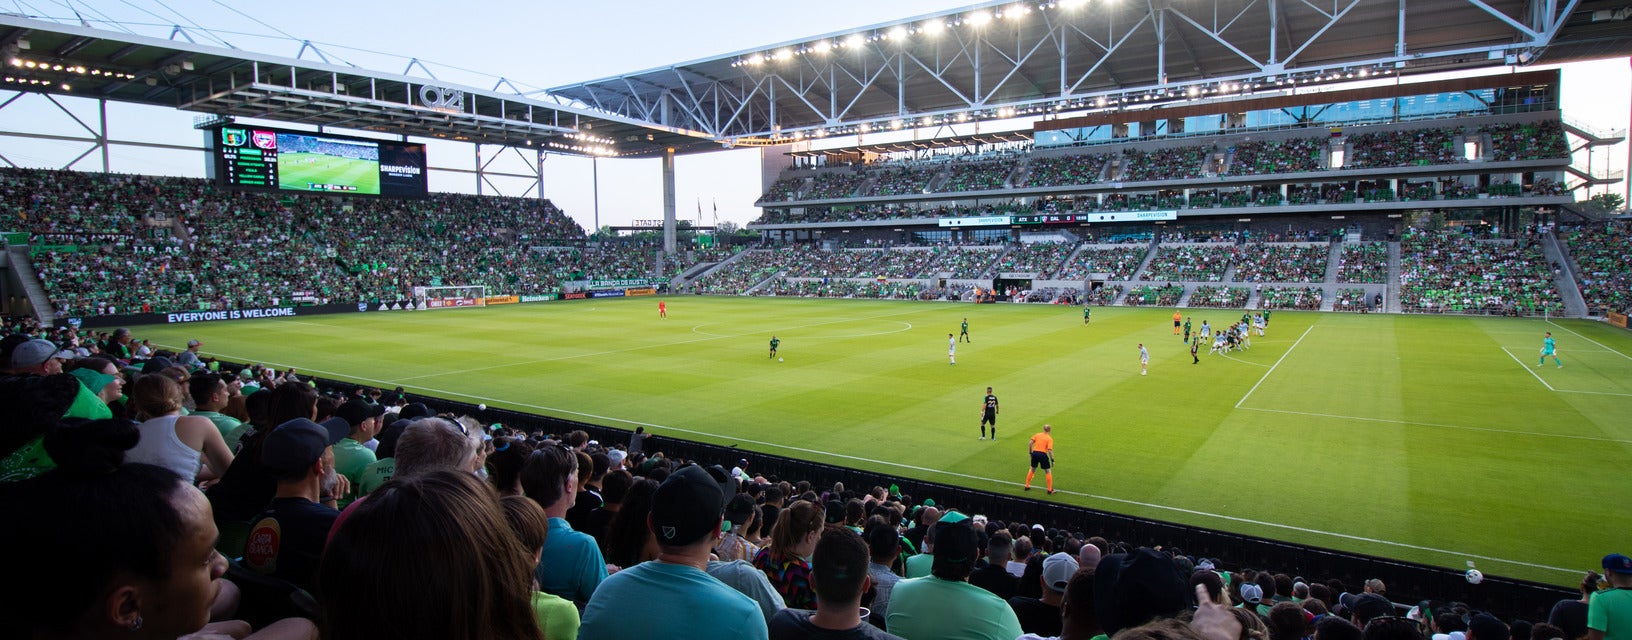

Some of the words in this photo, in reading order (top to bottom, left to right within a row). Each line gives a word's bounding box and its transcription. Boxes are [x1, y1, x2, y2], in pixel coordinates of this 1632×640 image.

[521, 295, 549, 303] Heineken
[167, 311, 228, 323] EVERYONE
[229, 310, 240, 319] IS
[242, 307, 297, 318] WELCOME.
